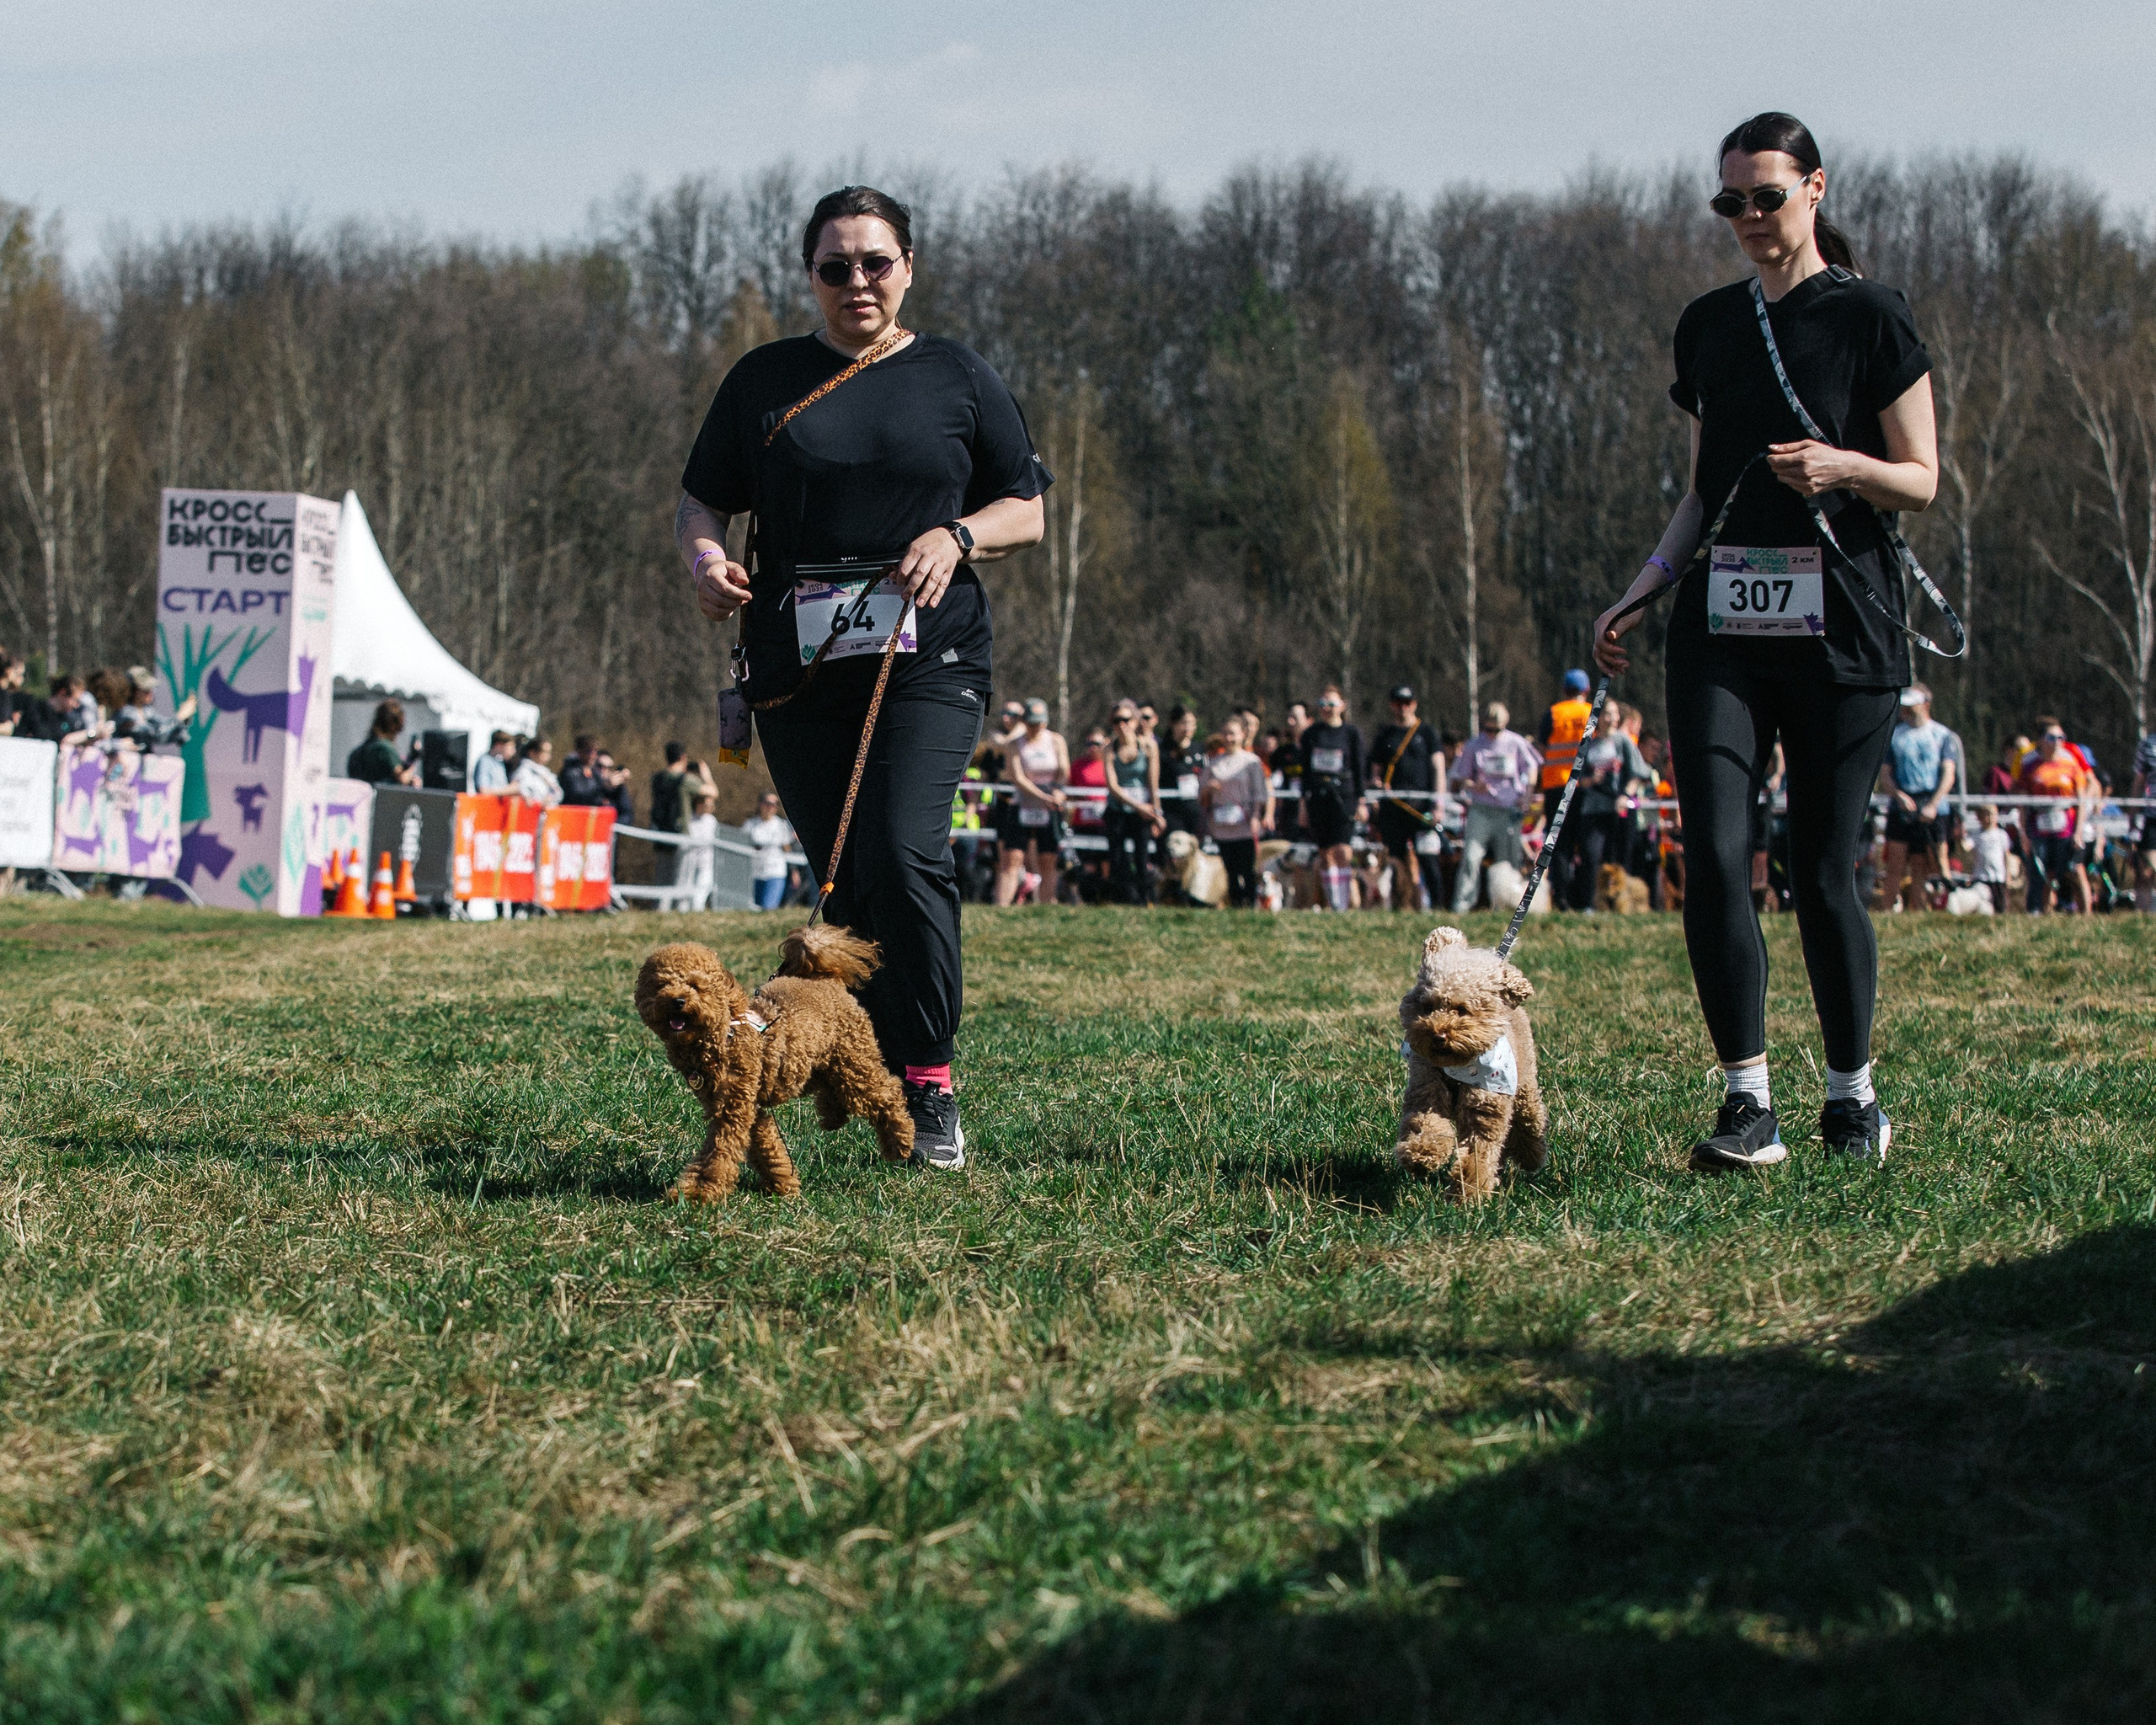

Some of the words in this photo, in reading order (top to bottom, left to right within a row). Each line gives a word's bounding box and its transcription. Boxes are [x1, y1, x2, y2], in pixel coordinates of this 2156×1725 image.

[168, 498, 268, 522] КРОСС
[162, 587, 291, 615] СТАРТ
[1729, 579, 1793, 612] 307
[830, 601, 875, 634] 64
